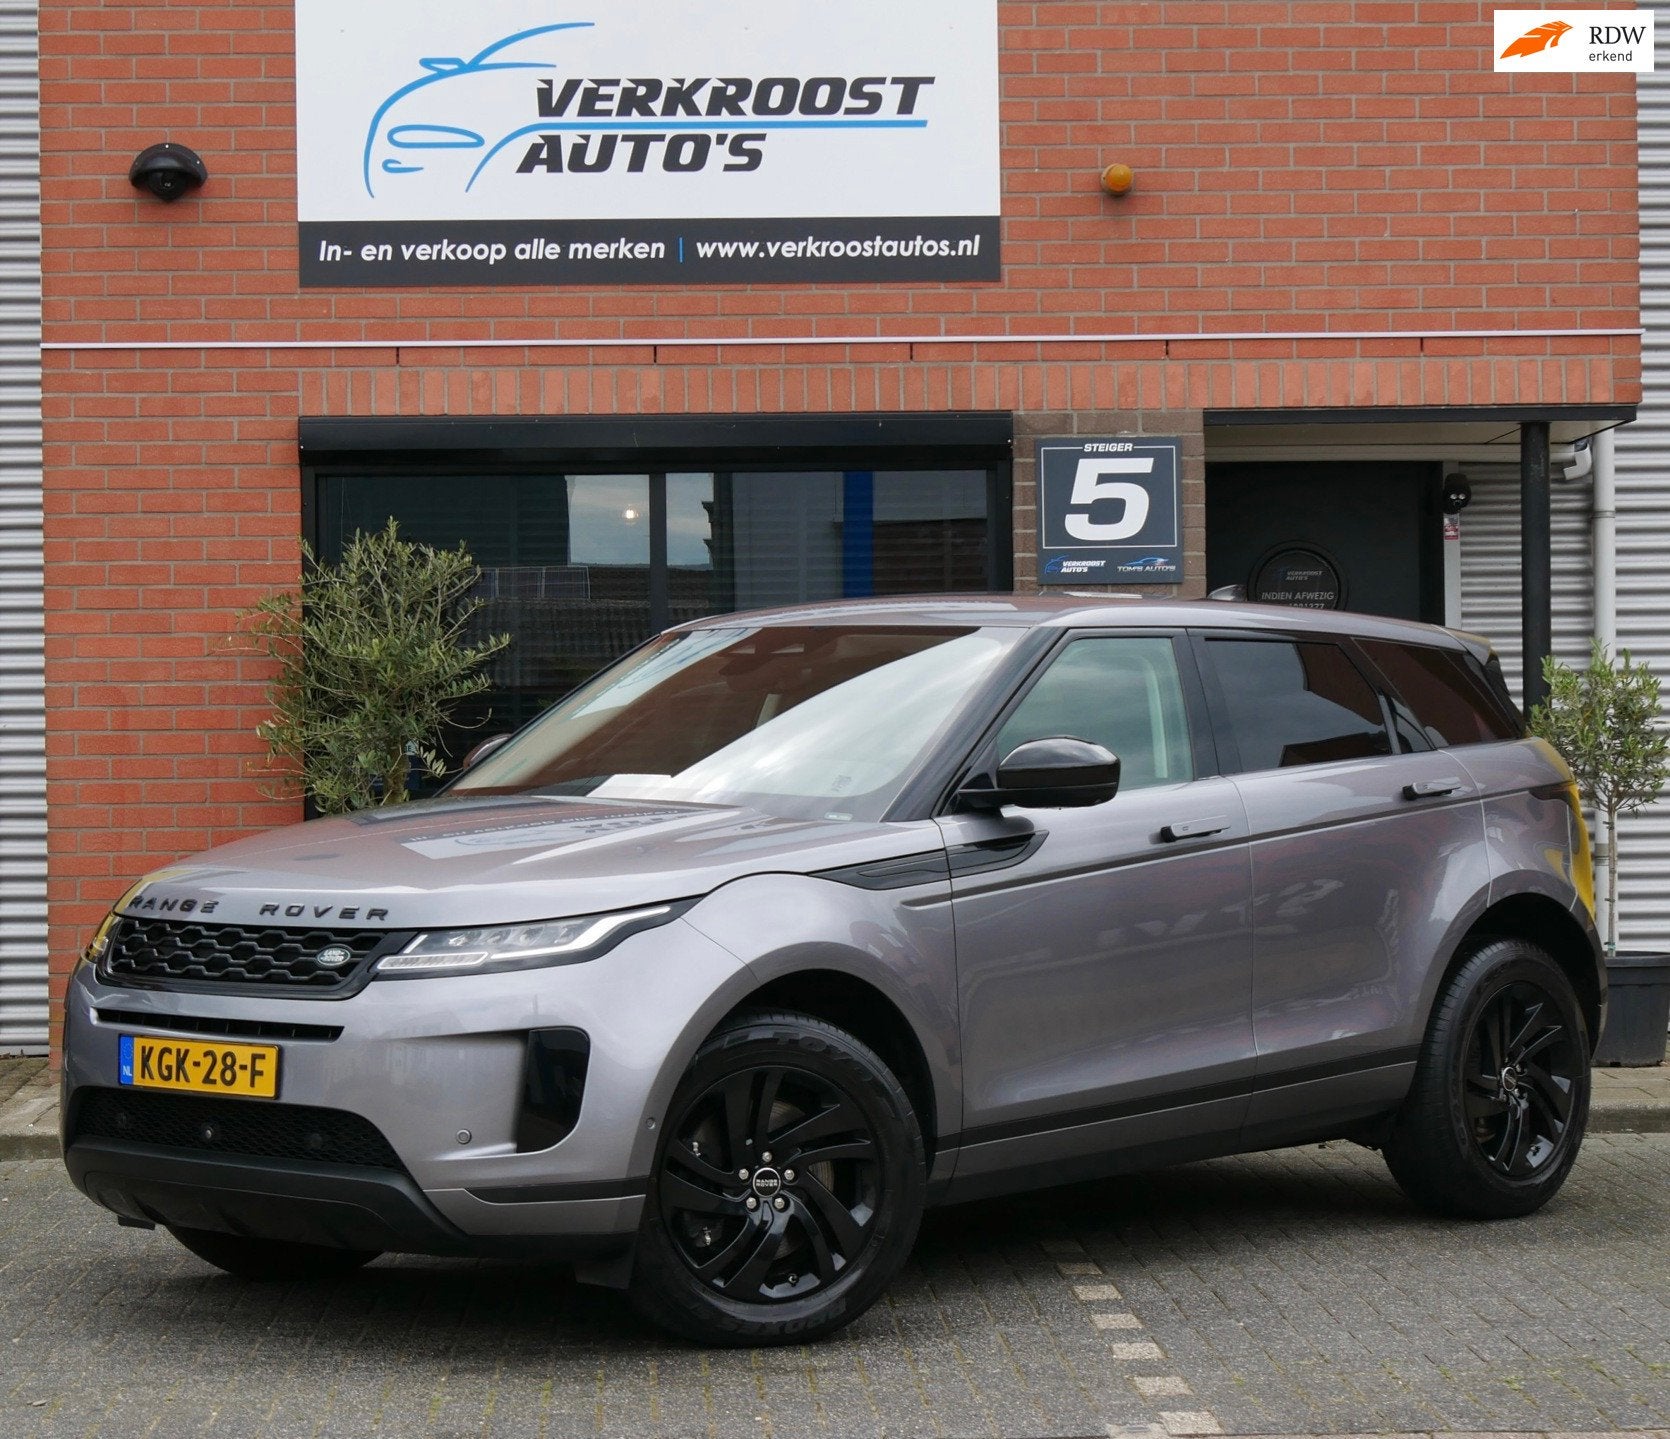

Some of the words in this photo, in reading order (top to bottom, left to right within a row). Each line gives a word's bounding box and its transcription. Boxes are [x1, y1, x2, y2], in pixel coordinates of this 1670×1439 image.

[536, 76, 936, 117] VERKROOST
[515, 132, 767, 174] AUTO'S
[319, 239, 352, 262] In-
[361, 243, 393, 262] en
[401, 239, 507, 265] verkoop
[514, 238, 561, 261] alle
[568, 237, 666, 260] merken
[696, 234, 981, 259] www.verkroostautos.nl
[1083, 443, 1134, 453] STEIGER
[1064, 457, 1154, 541] 5
[1261, 591, 1292, 600] INDIEN
[1294, 591, 1335, 600] AFWEZIG
[128, 895, 220, 915] RANGE
[259, 900, 390, 922] ROVER
[122, 1064, 133, 1077] NL
[140, 1044, 267, 1089] KGK-28-F
